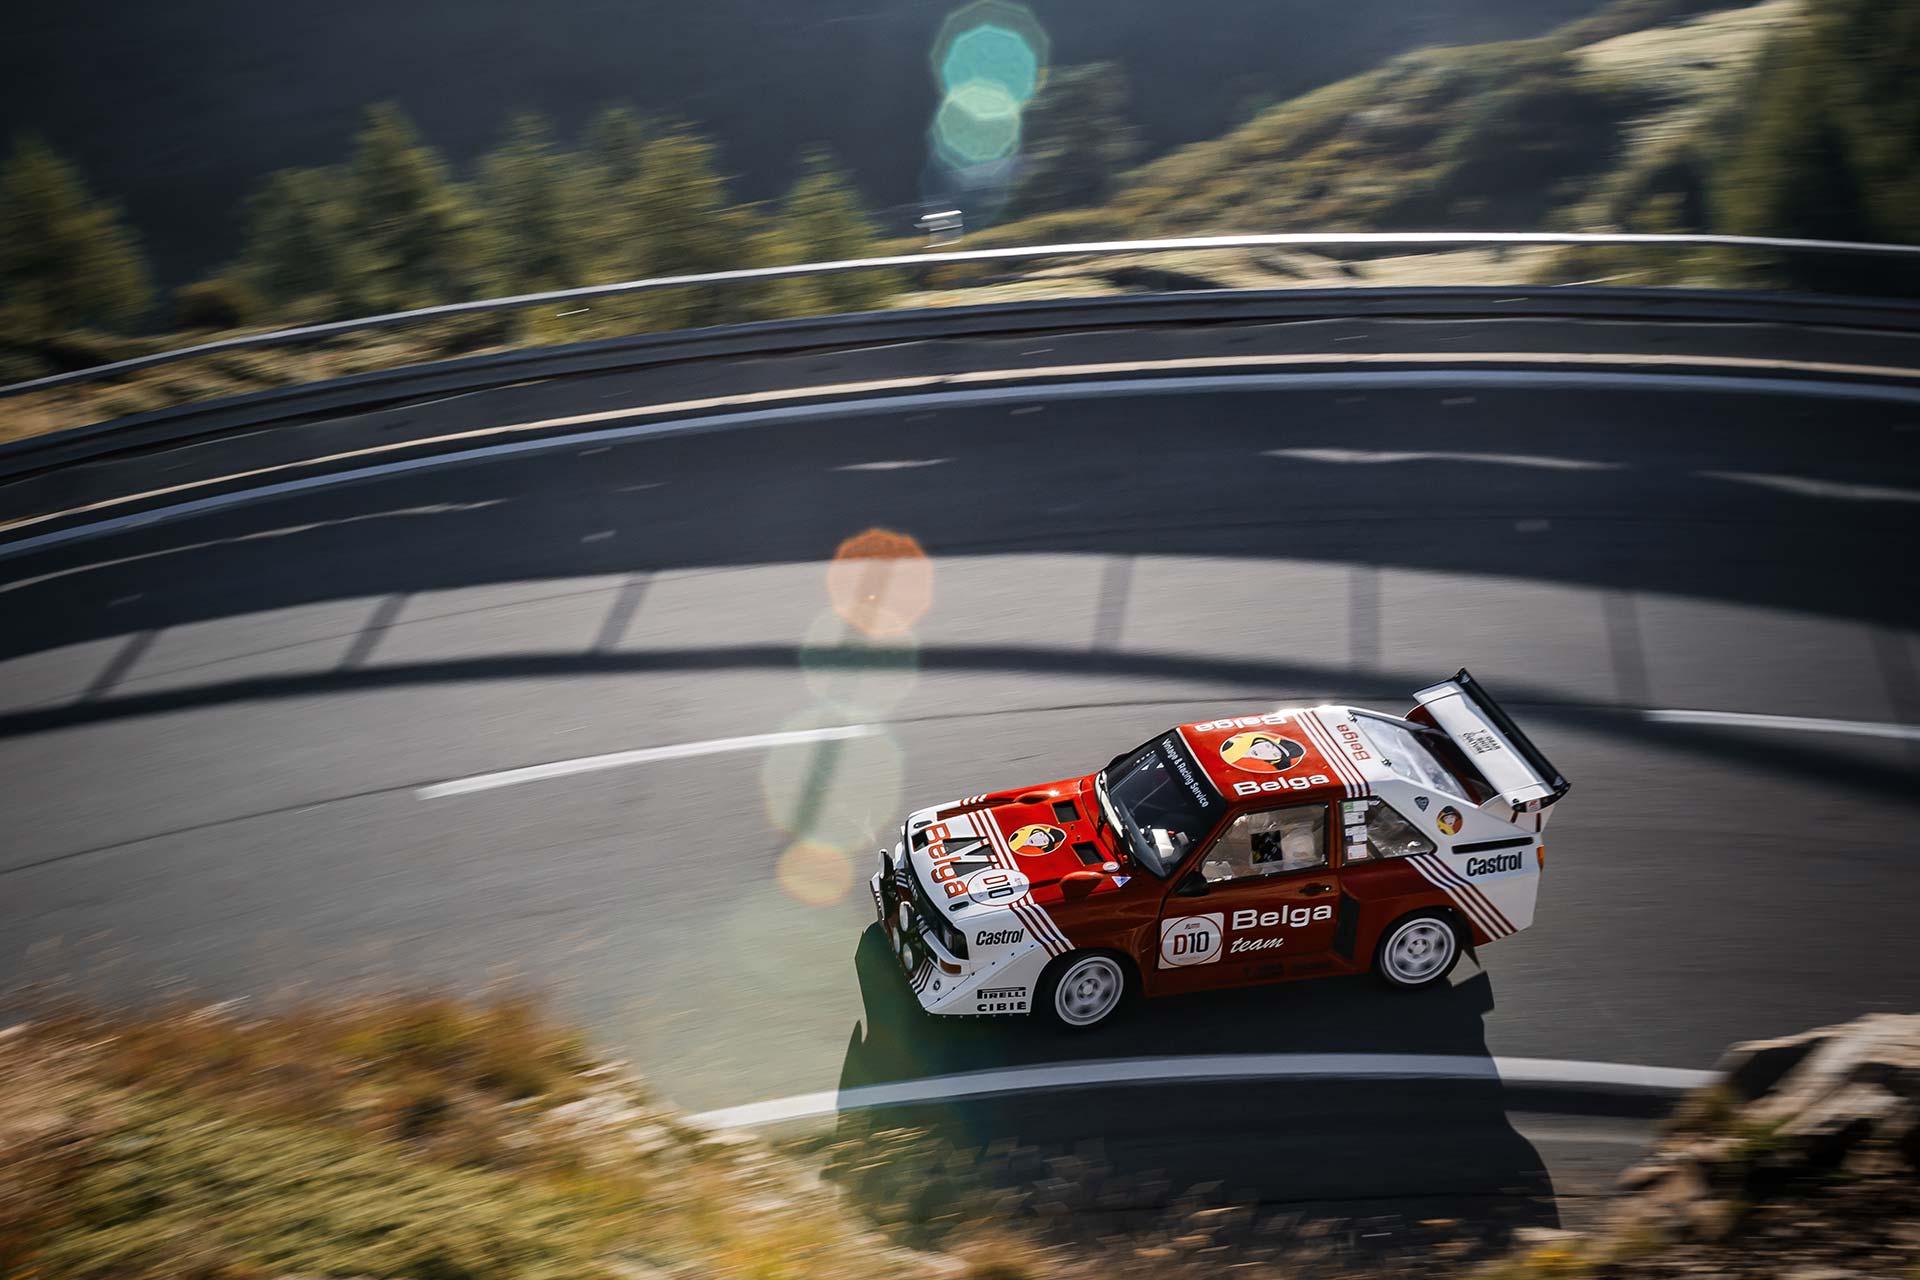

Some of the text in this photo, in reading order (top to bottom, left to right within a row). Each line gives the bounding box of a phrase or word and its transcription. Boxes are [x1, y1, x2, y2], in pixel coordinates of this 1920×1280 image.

[1195, 714, 1288, 732] Belga
[1336, 724, 1372, 761] Belga
[1162, 738, 1178, 760] Vintage
[1177, 762, 1194, 786] Racing
[1190, 782, 1209, 808] Service
[1233, 774, 1330, 796] Belga
[924, 822, 968, 898] Belga
[1467, 851, 1522, 877] Castrol
[983, 875, 1014, 898] D10
[1232, 905, 1332, 931] Belga
[976, 928, 1024, 946] Castrol
[1173, 931, 1210, 955] D10
[1230, 937, 1284, 953] team
[977, 987, 1026, 999] PIRELLI
